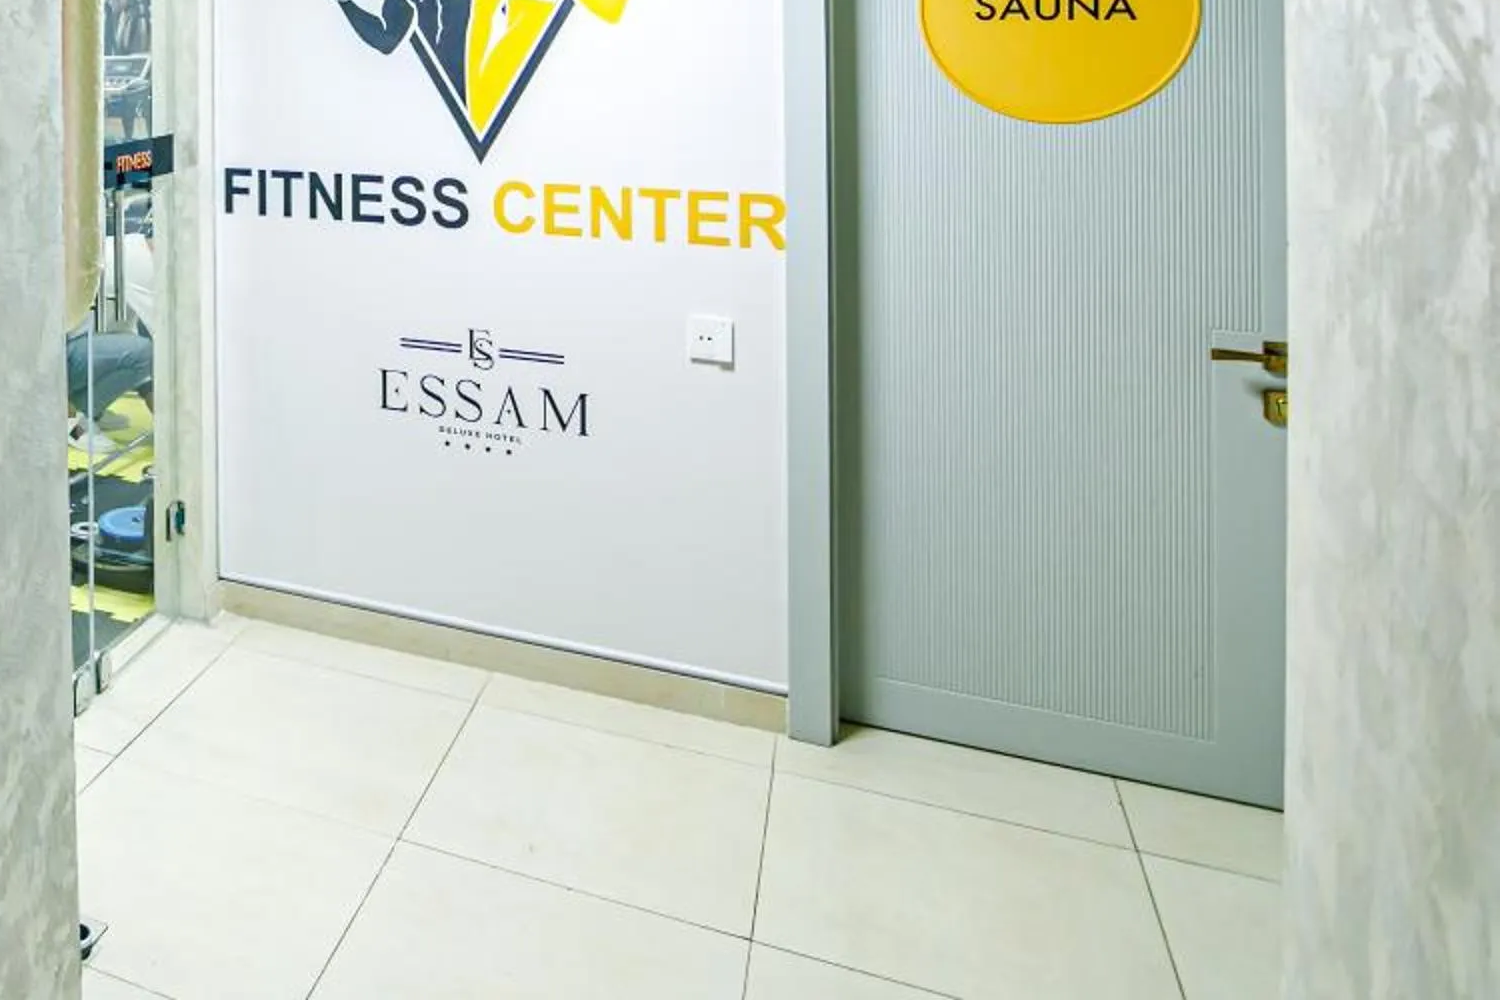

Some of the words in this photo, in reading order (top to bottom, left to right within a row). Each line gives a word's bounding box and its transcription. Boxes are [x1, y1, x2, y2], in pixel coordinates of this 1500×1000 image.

[223, 167, 470, 230] FITNESS
[493, 180, 787, 251] CENTER
[379, 367, 590, 437] ESSAM
[438, 425, 481, 439] DELUXE
[485, 430, 522, 446] HOTEL
